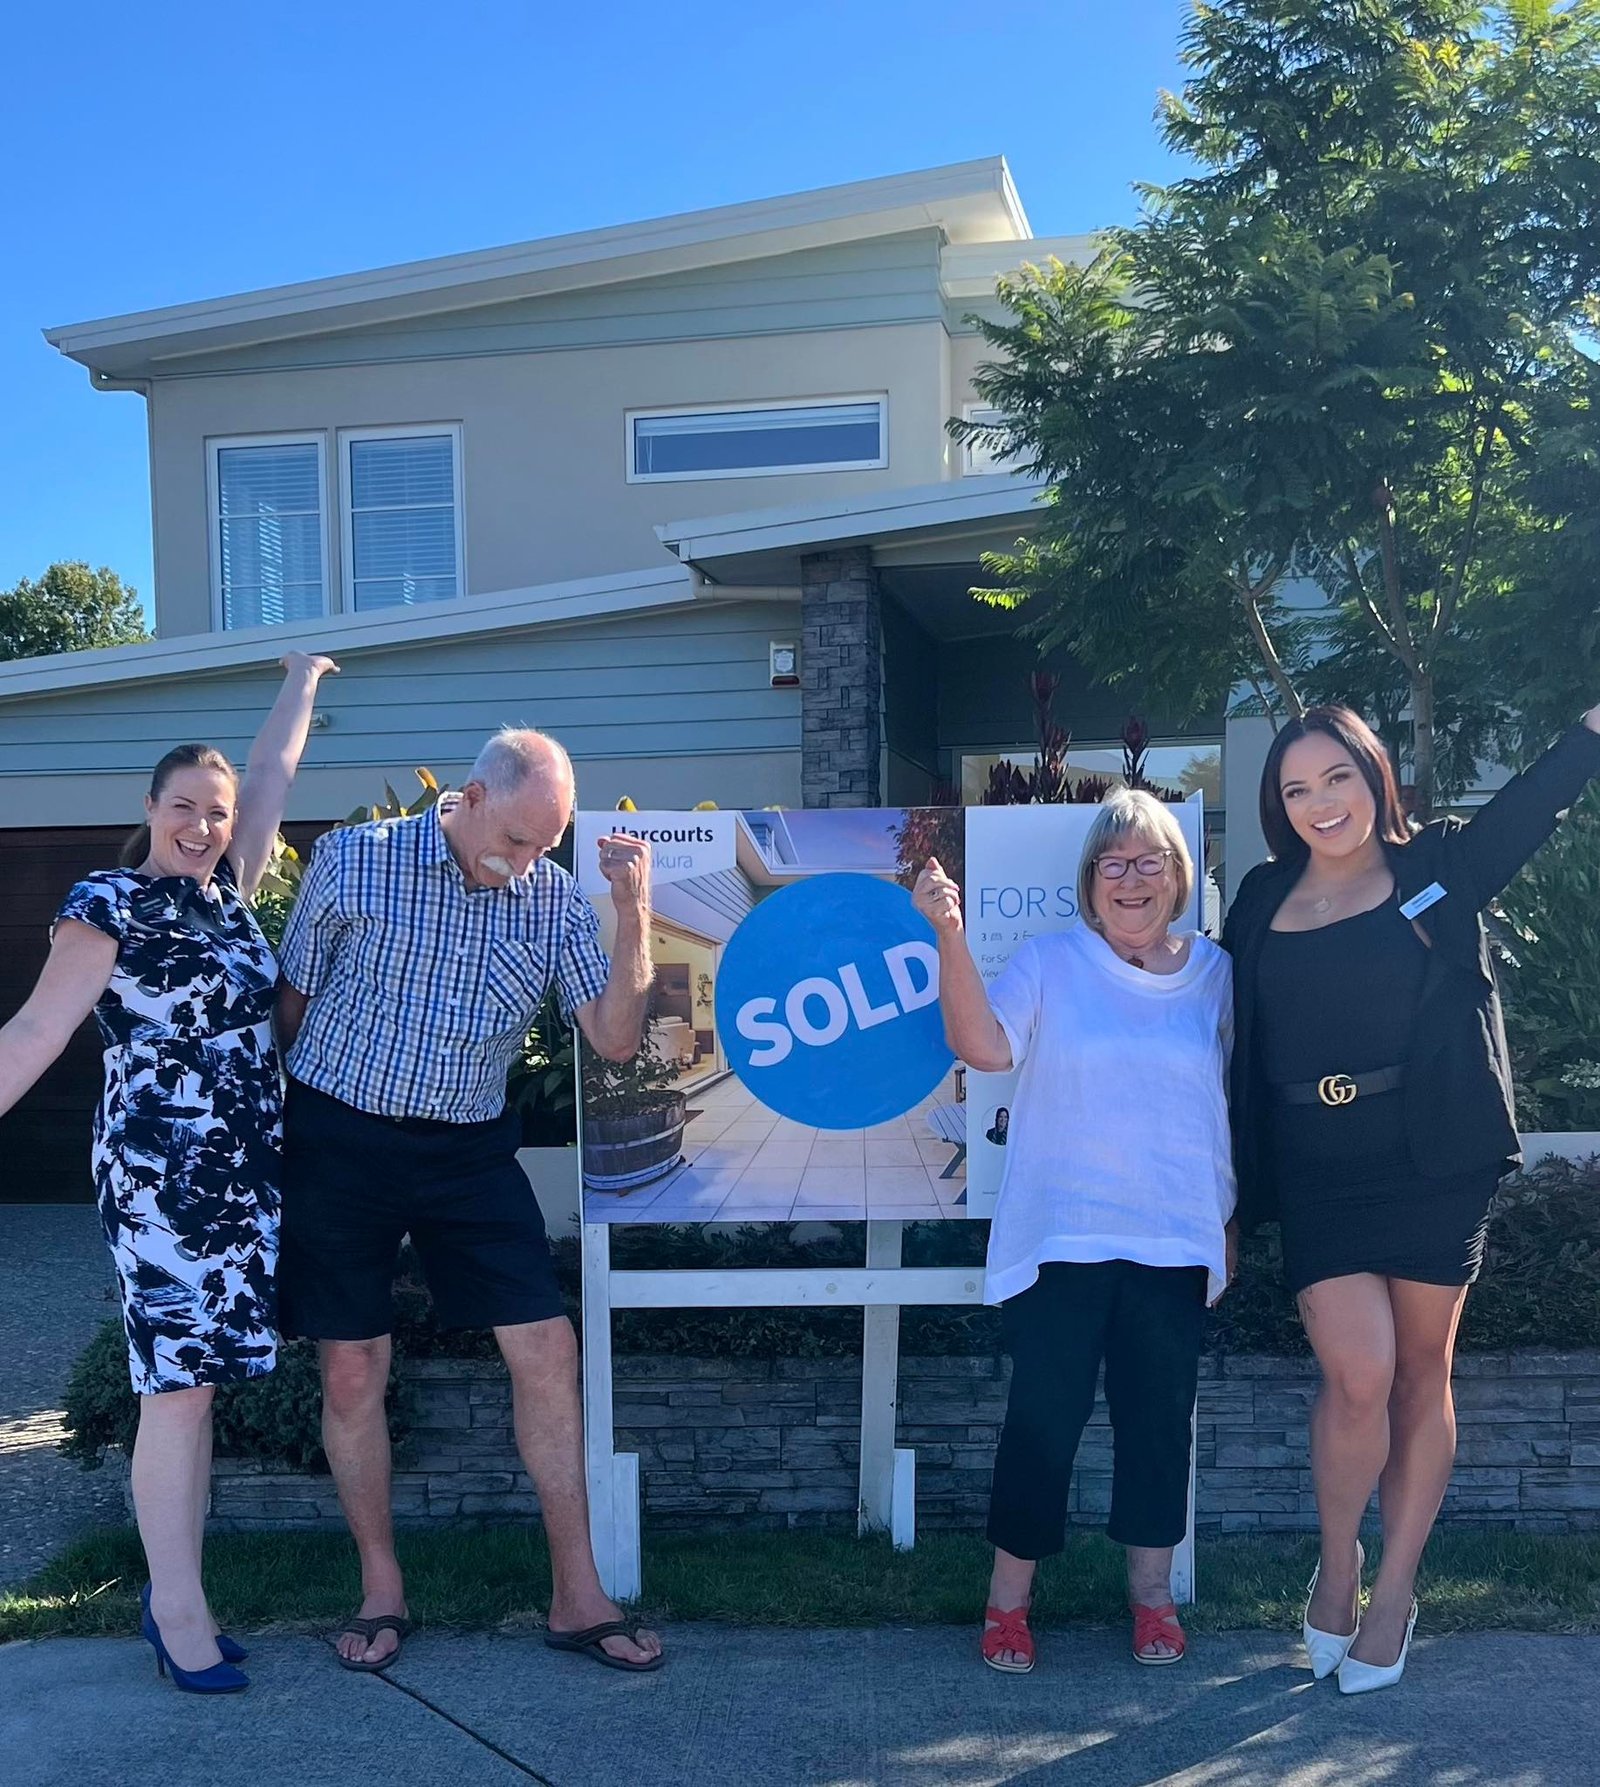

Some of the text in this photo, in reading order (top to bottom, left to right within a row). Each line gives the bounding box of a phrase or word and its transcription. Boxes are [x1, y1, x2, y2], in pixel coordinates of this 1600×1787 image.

[980, 886, 1080, 918] FOR S
[981, 932, 1019, 942] 3 2
[735, 940, 940, 1067] SOLD
